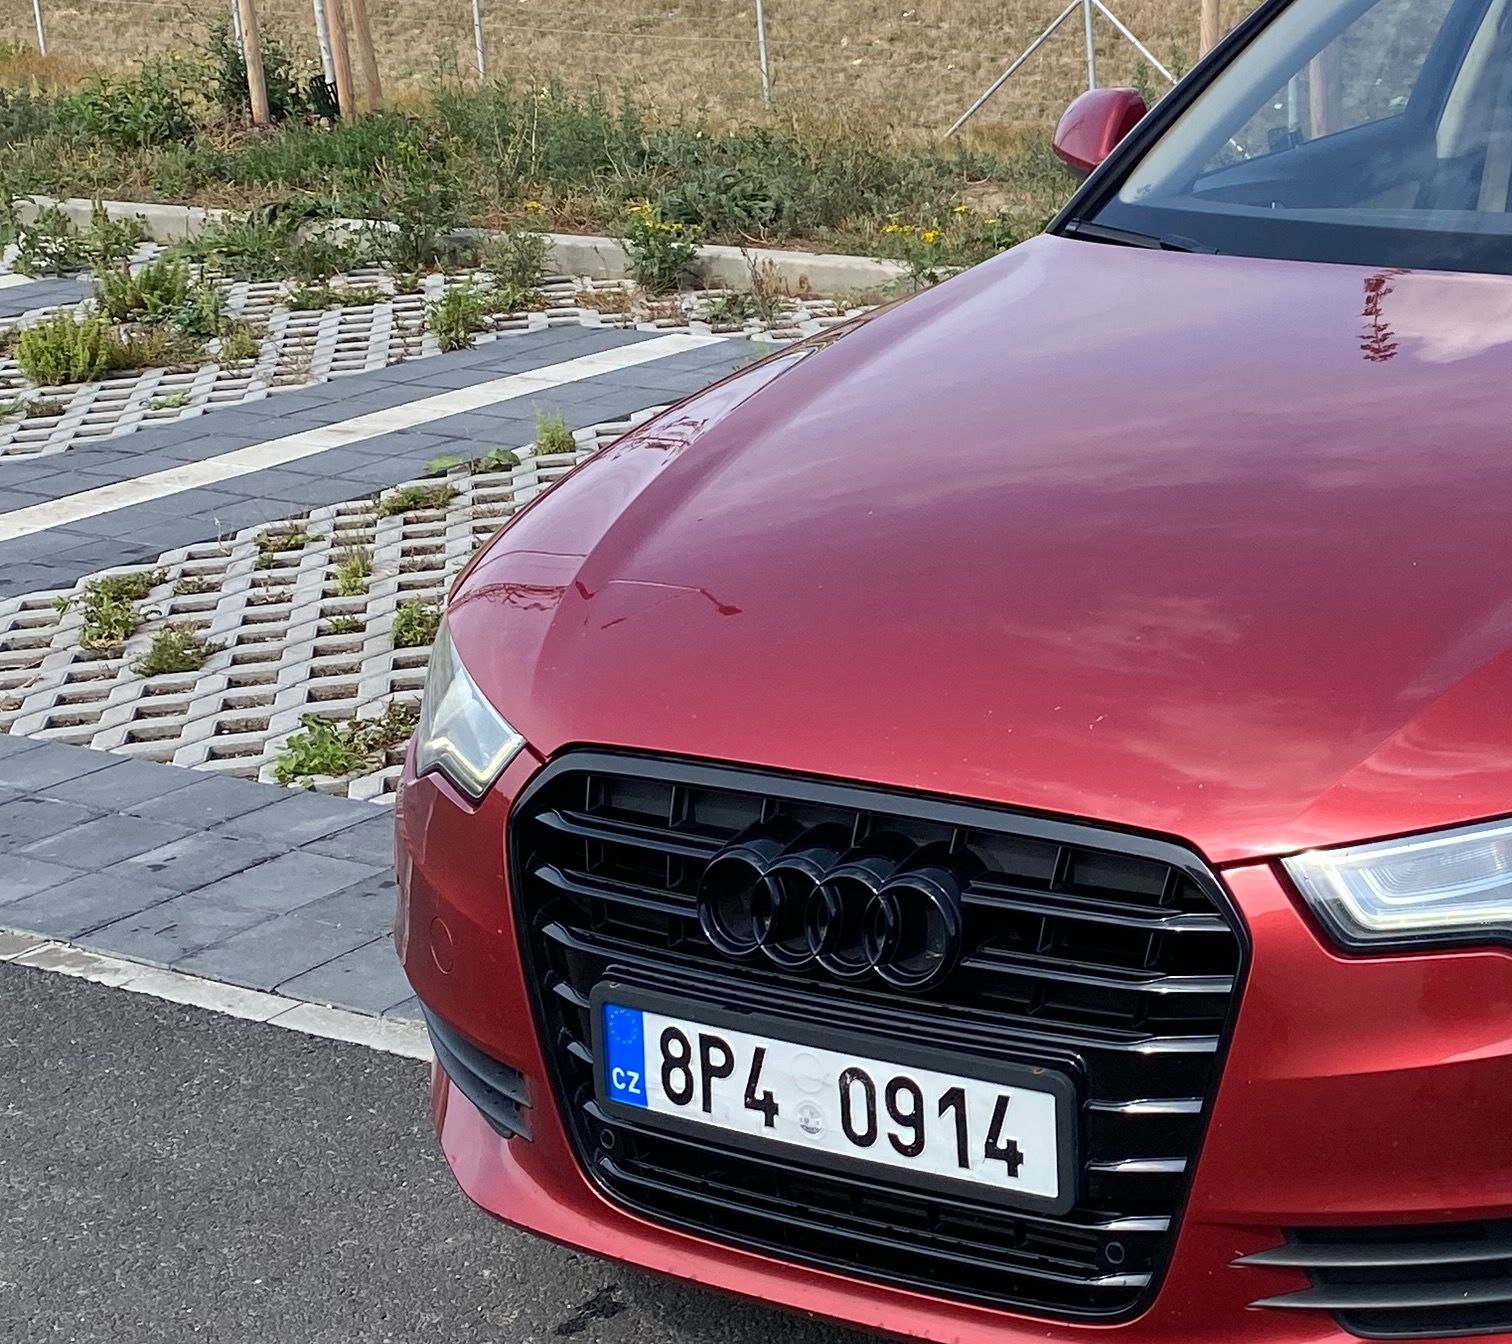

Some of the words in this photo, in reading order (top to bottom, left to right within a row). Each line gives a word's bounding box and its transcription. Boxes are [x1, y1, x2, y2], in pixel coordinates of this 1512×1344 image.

[611, 1067, 641, 1094] CZ
[659, 1026, 779, 1129] 8P4
[837, 1066, 1025, 1179] 0914
